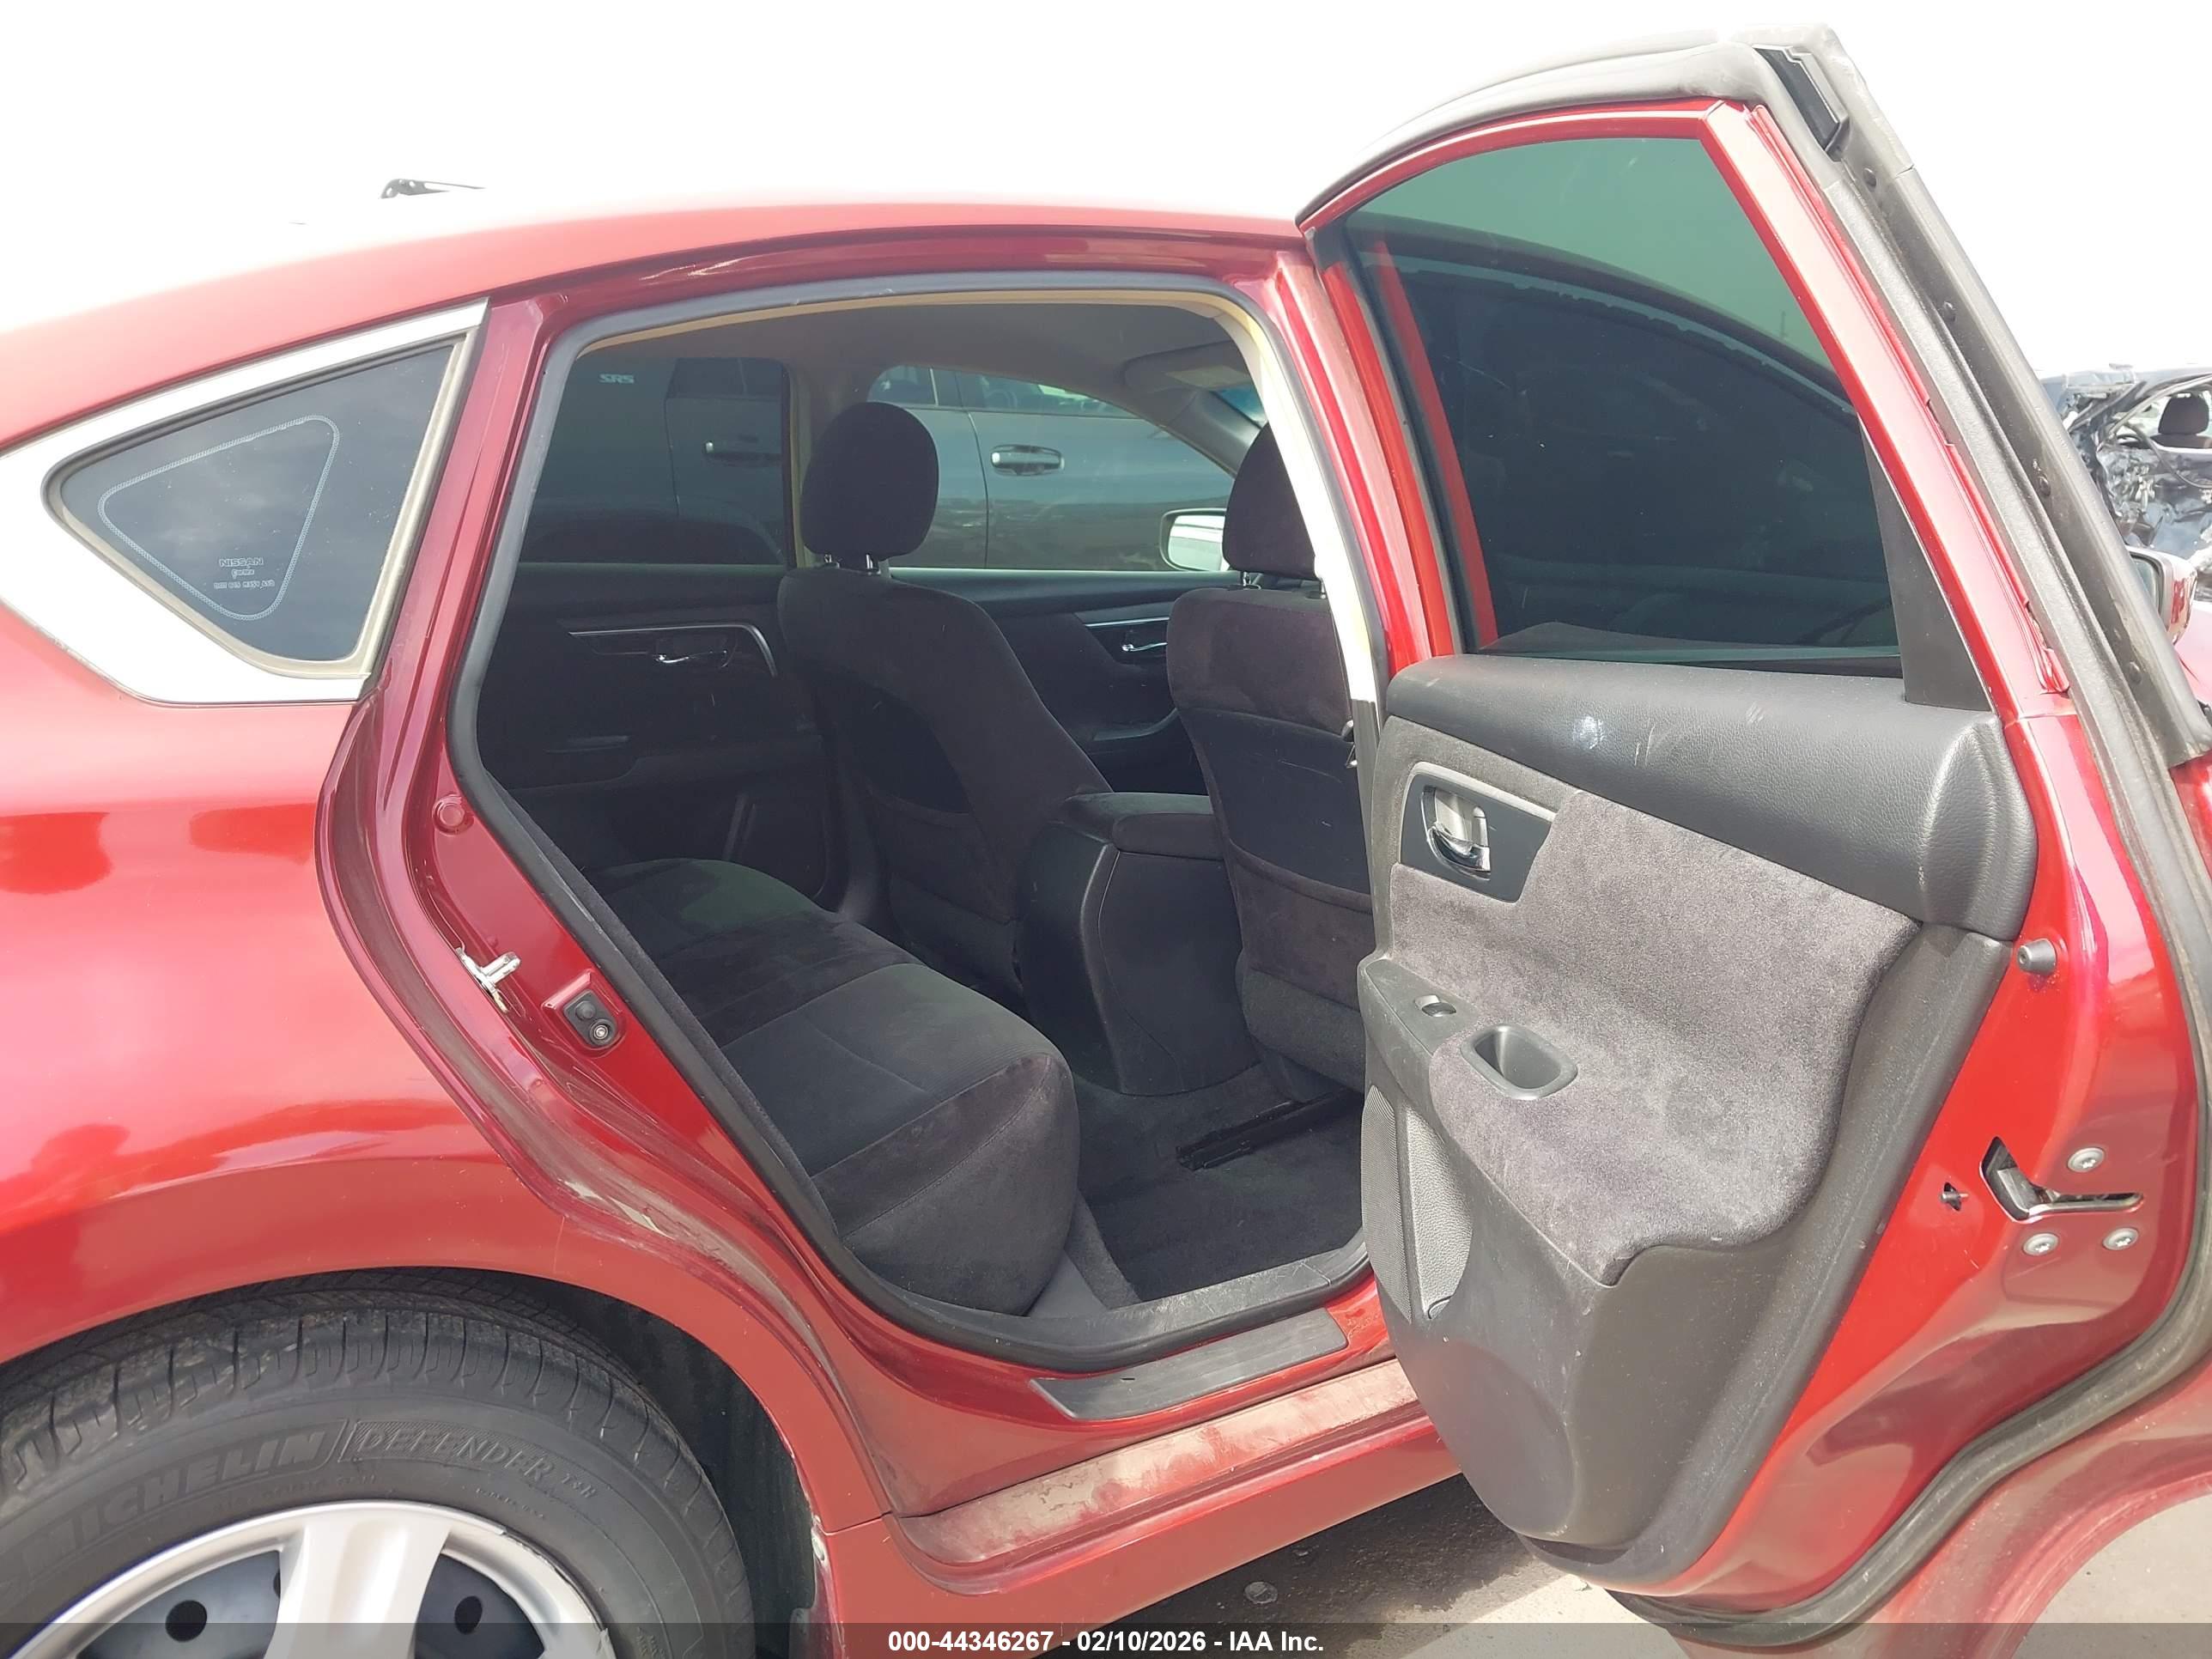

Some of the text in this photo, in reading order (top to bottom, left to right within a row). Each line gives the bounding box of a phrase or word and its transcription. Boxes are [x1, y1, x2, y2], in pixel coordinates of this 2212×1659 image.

[599, 374, 635, 384] SRS
[219, 557, 264, 568] NISSAN
[23, 1431, 326, 1578] MICHELIN
[357, 1428, 554, 1482] DEFENDER
